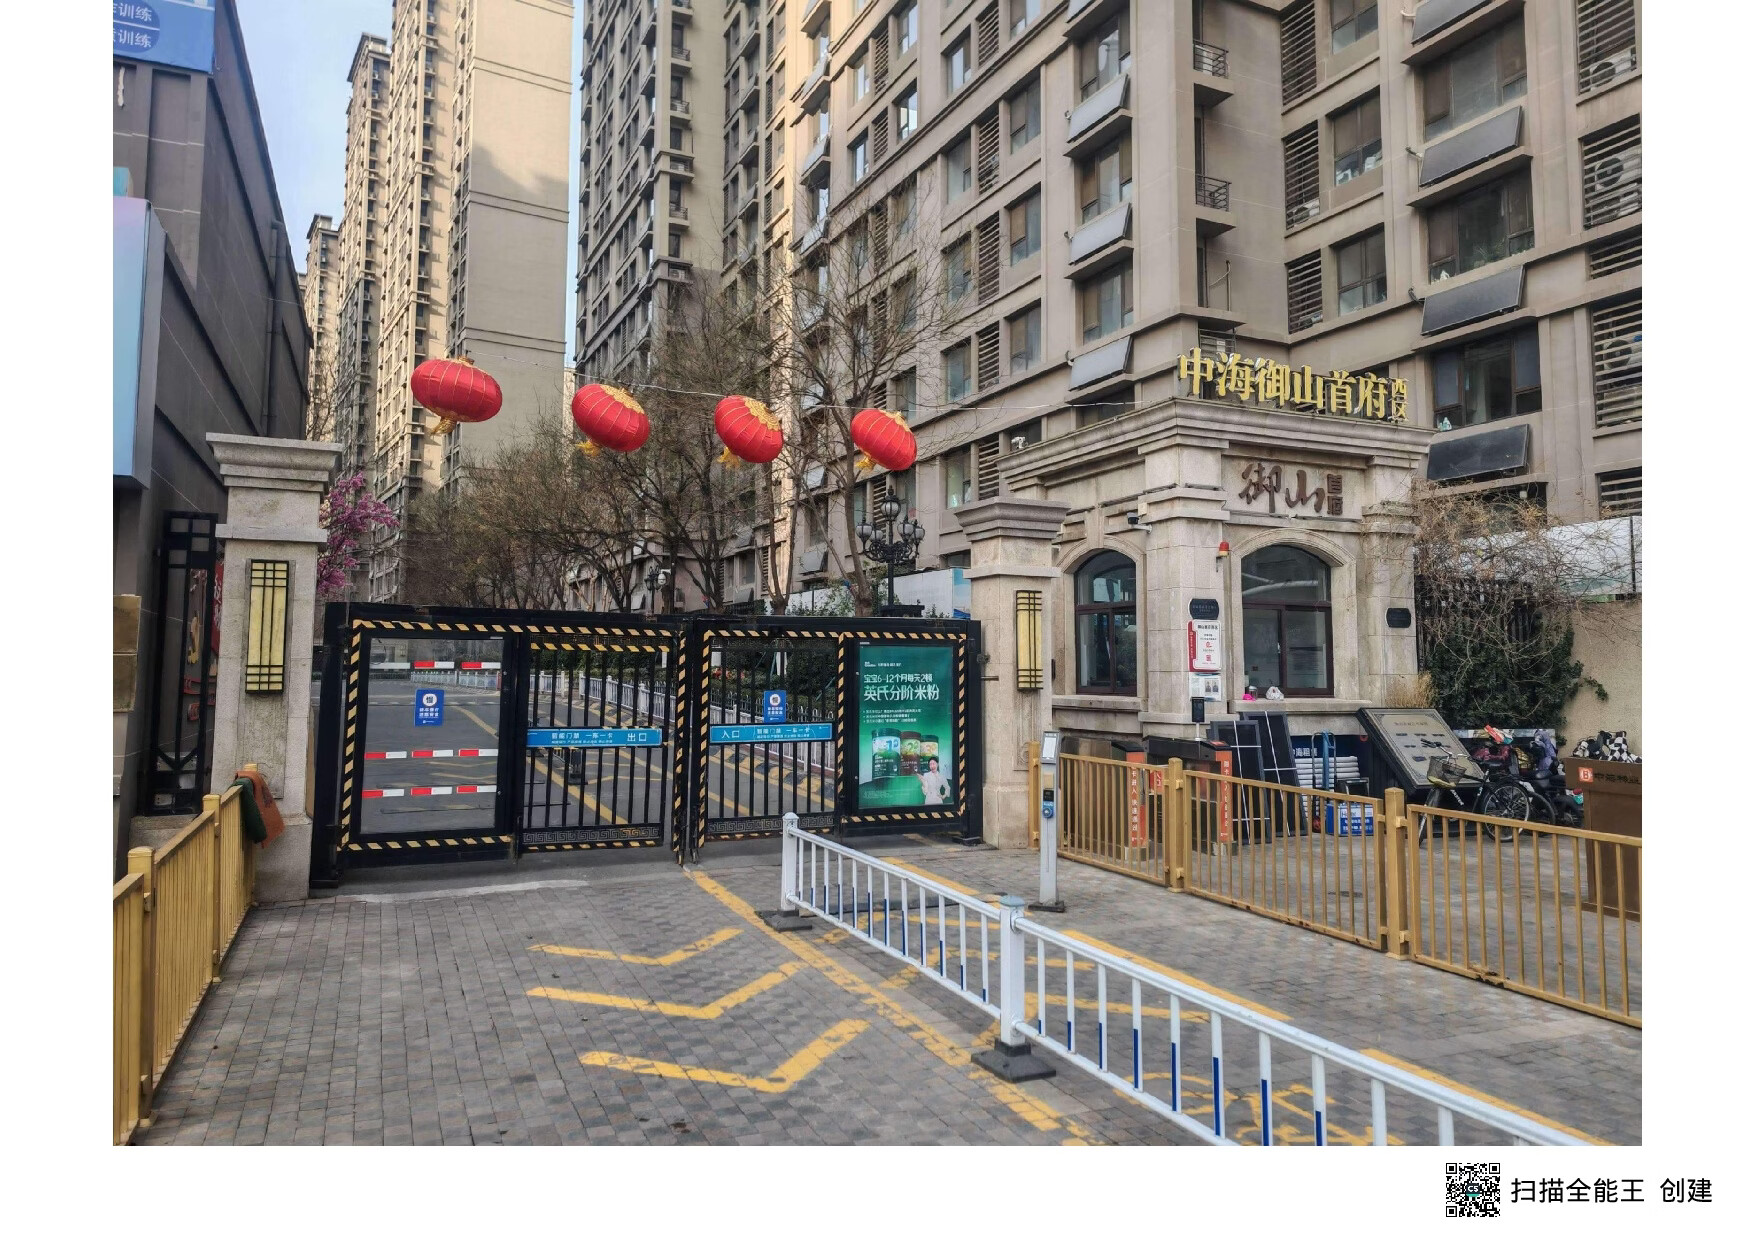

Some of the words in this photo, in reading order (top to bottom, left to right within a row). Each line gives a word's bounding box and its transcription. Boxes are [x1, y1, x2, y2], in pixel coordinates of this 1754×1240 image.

[1178, 347, 1388, 419] 中海御山首府
[864, 684, 940, 701] 英氏分阶米粉
[627, 732, 647, 742] 出口
[721, 730, 740, 739] 入口
